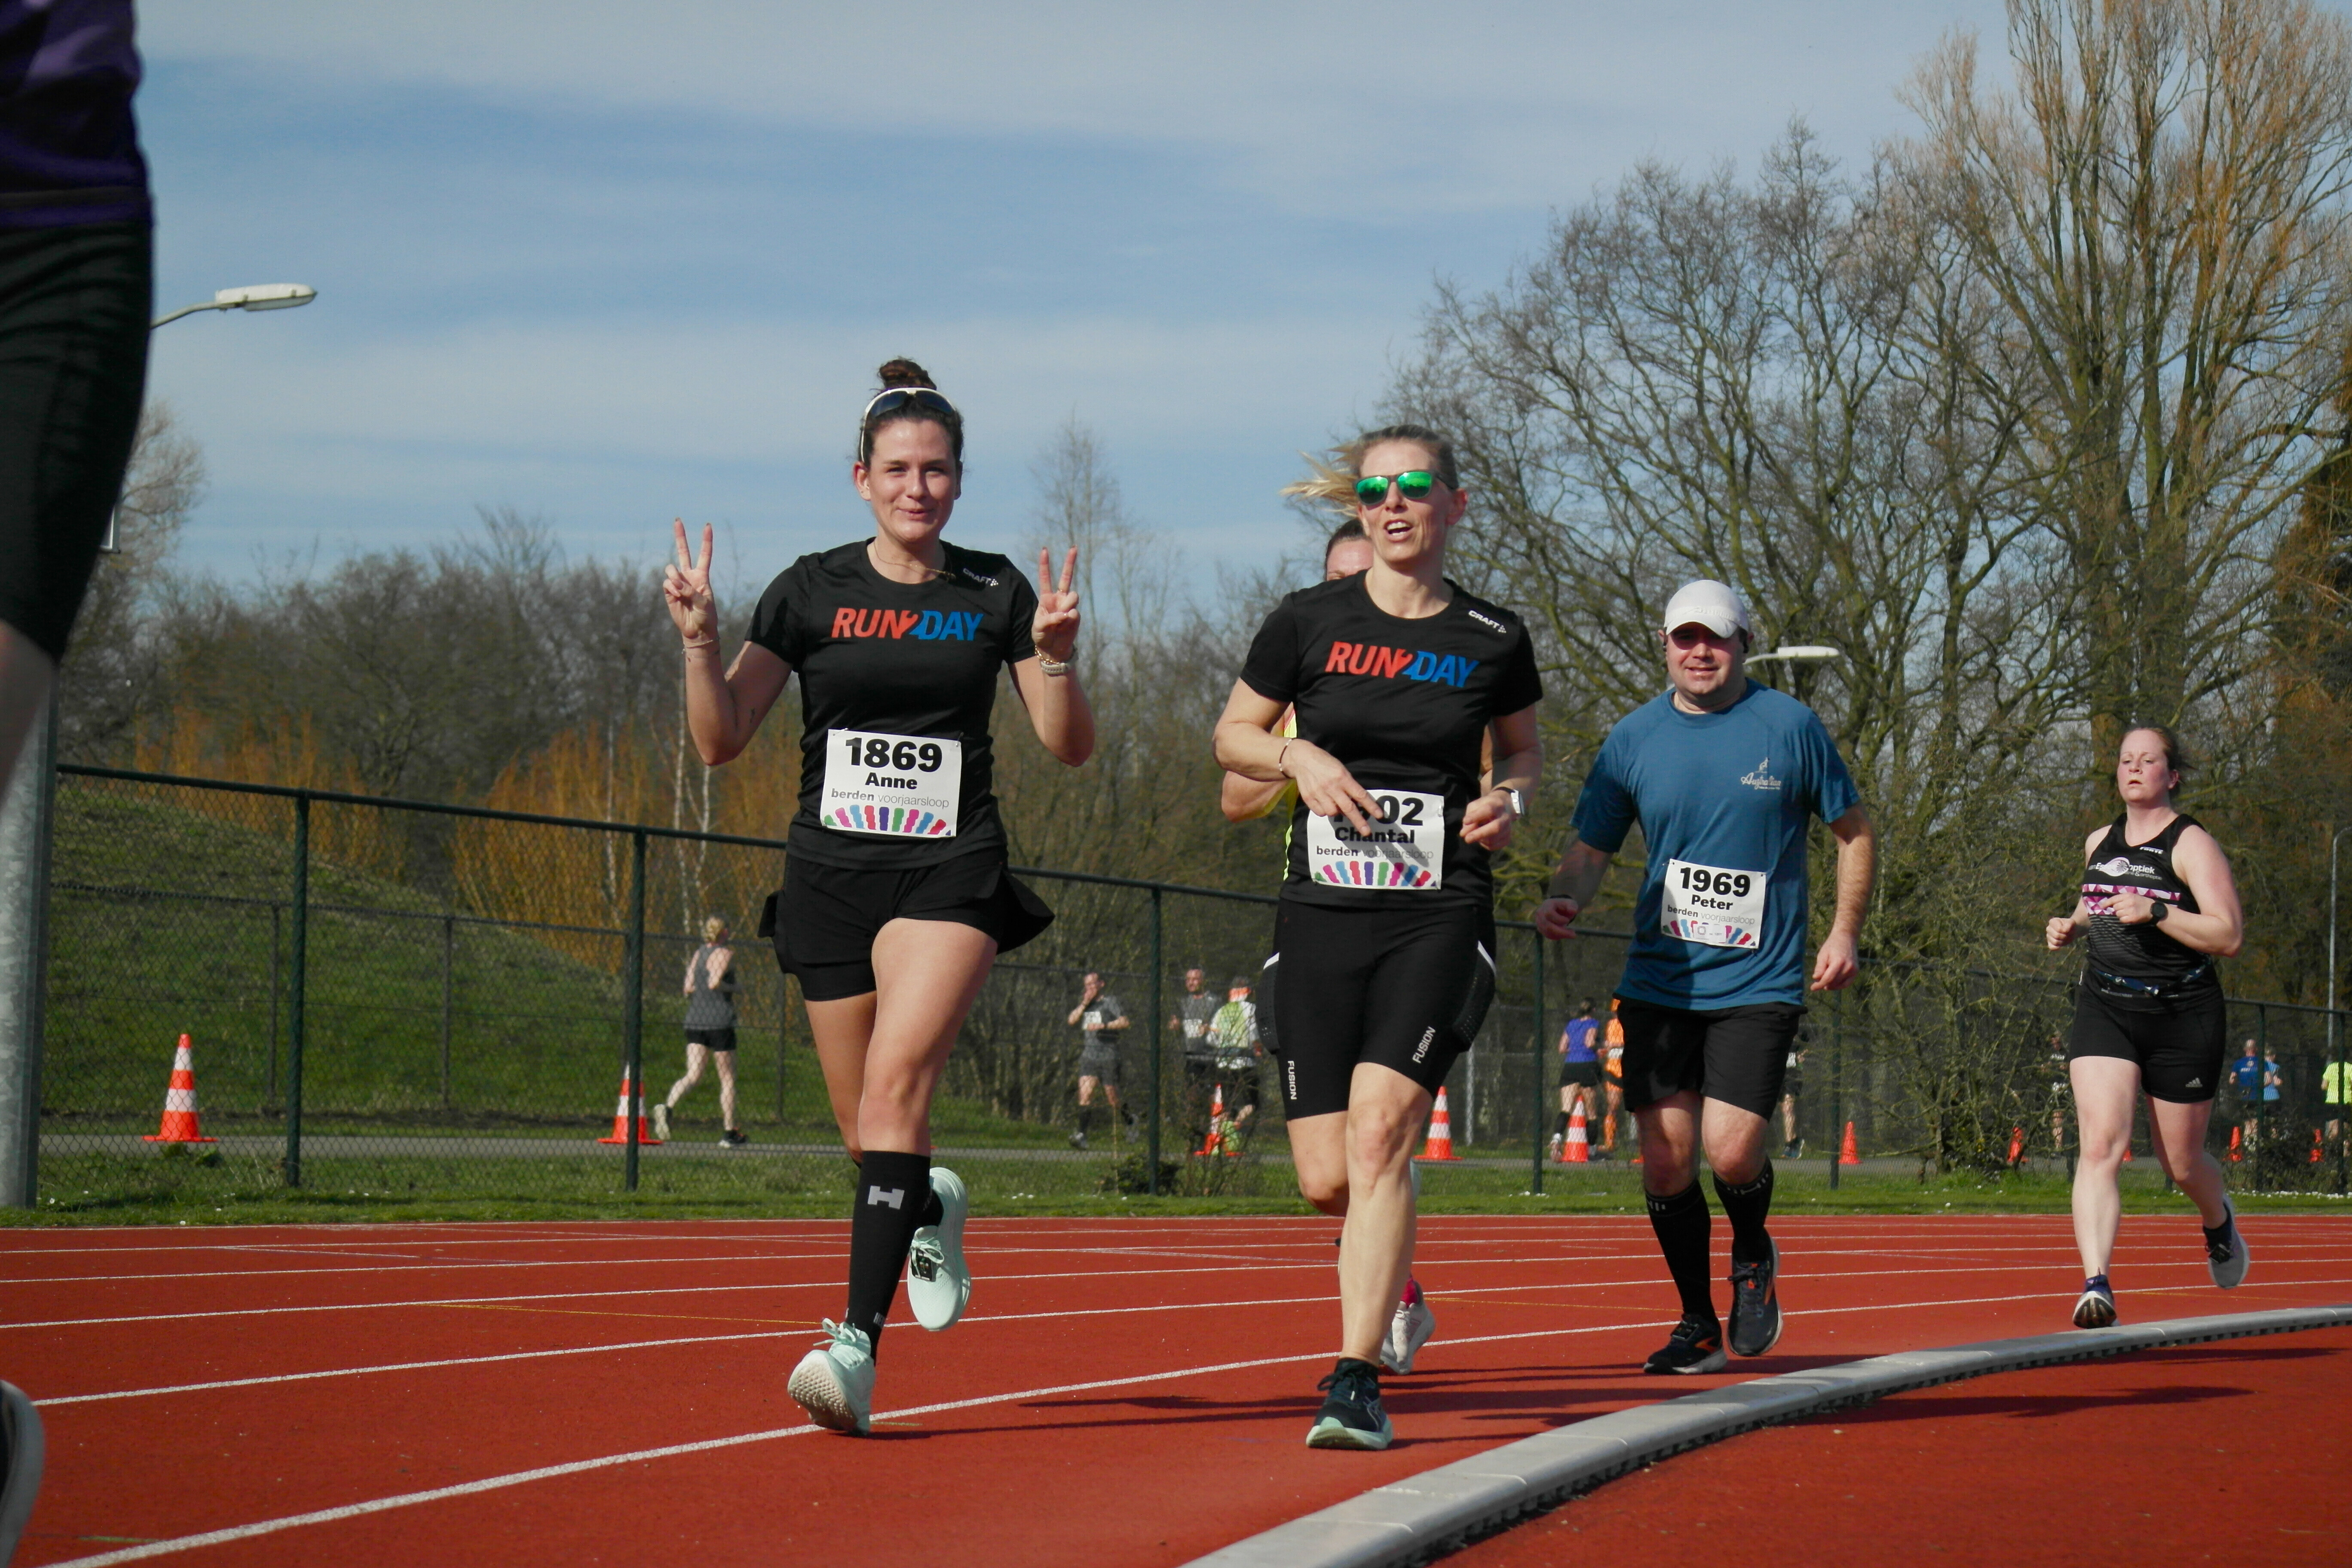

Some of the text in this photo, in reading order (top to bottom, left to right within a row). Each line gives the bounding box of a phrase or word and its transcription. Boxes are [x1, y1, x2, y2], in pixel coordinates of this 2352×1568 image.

[962, 567, 991, 584] CRAFT
[1468, 609, 1499, 629] CRAFT
[845, 737, 942, 772] 1869
[865, 772, 917, 789] Anne
[831, 788, 949, 809] berden voorjaarsloop
[1333, 795, 1424, 826] 02
[1317, 845, 1434, 860] berden voorjaarsloop
[1680, 867, 1750, 897] 1969
[1691, 894, 1733, 910] Peter
[1668, 904, 1755, 925] berden voorjaarsloop
[1412, 1026, 1436, 1063] FUSION
[1287, 1060, 1297, 1100] FUSION
